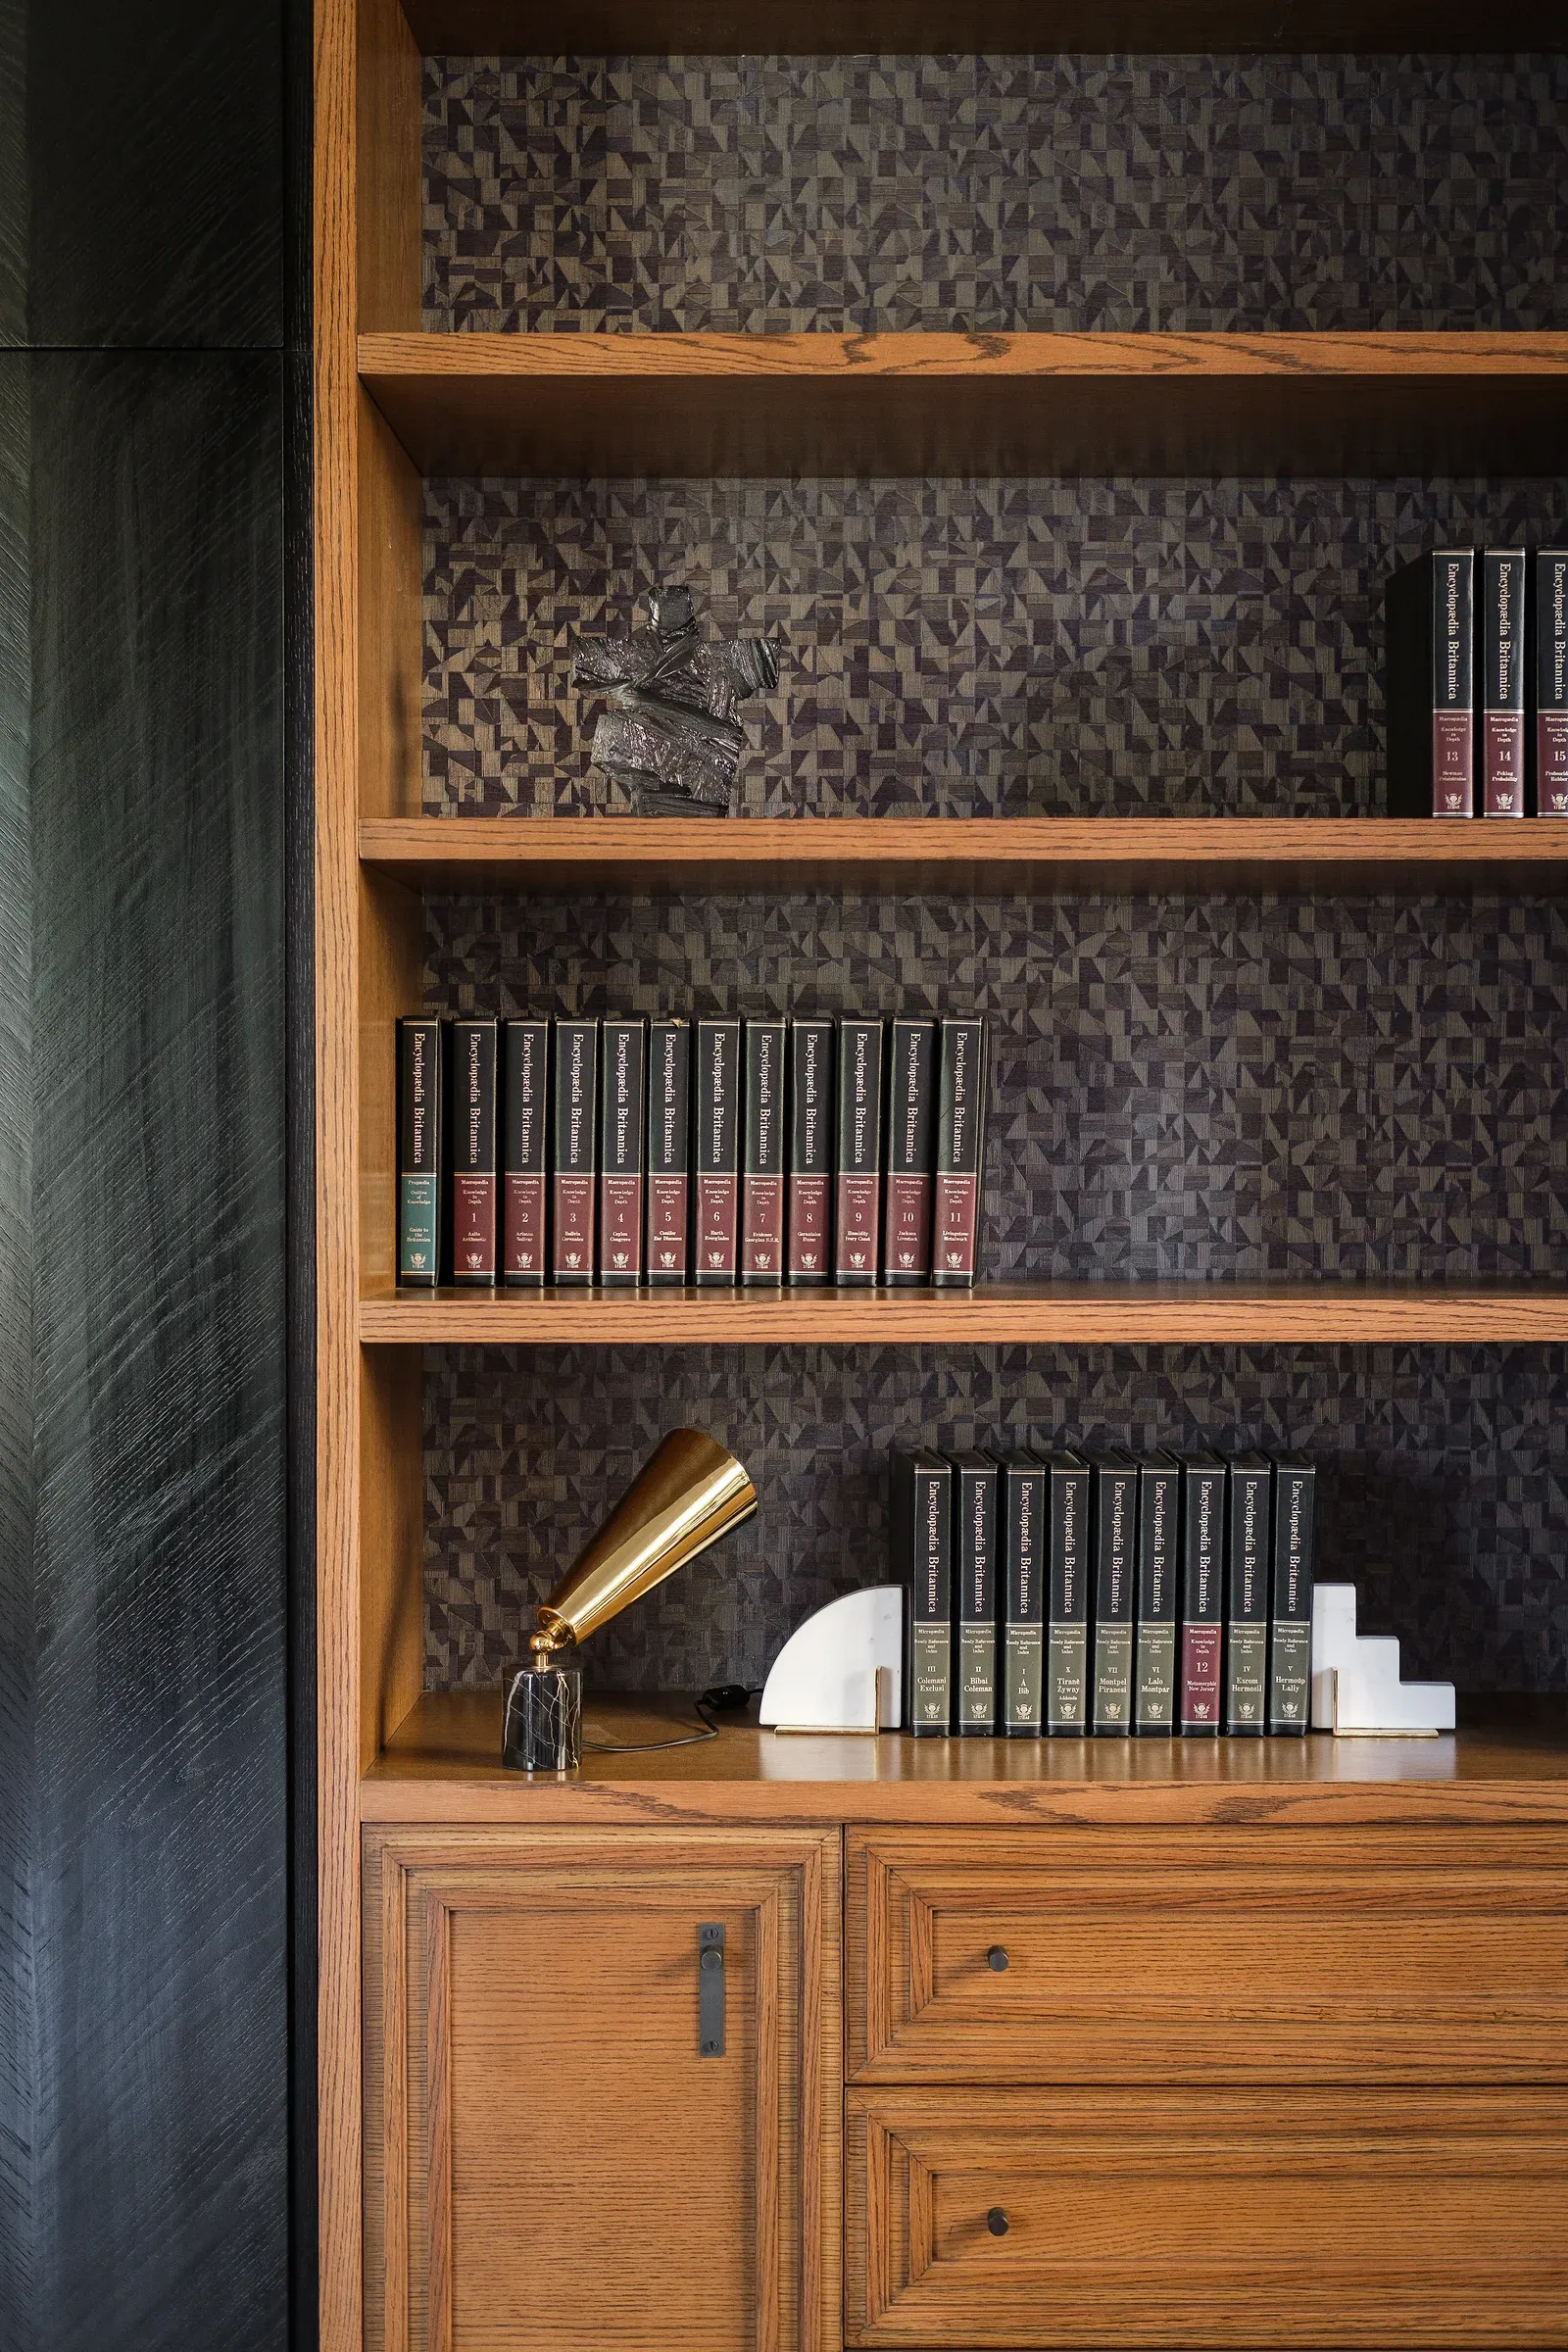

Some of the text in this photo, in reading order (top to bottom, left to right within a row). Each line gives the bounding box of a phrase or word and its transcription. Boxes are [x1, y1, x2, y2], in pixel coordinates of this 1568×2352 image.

[1446, 564, 1459, 700] Encyclopædia Britannica
[1498, 564, 1511, 700] Encyclopædia Britannica
[1553, 564, 1566, 700] Encyclopædia Britannica
[1446, 752, 1458, 760] 13
[1499, 752, 1511, 760] 14
[1554, 752, 1566, 760] 15
[413, 1033, 425, 1164] Encyclopædia Britannica
[468, 1034, 481, 1164] Encyclopædia Britannica
[521, 1034, 534, 1164] Encyclopædia Britannica
[570, 1034, 584, 1164] Encyclopædia Britannica
[615, 1034, 629, 1164] Encyclopædia Britannica
[662, 1034, 676, 1164] Encyclopædia Britannica
[711, 1033, 725, 1163] Encyclopædia Britannica
[759, 1034, 772, 1165] Encyclopædia Britannica
[805, 1034, 818, 1164] Encyclopædia Britannica
[855, 1033, 868, 1163] Encyclopædia Britannica
[906, 1033, 921, 1163] Encyclopædia Britannica
[954, 1032, 967, 1163] Encyclopædia Britannica
[471, 1213, 476, 1222] 1
[521, 1213, 529, 1222] 2
[570, 1213, 576, 1222] 3
[617, 1213, 623, 1223] 4
[665, 1212, 671, 1221] 5
[713, 1211, 719, 1221] 6
[760, 1213, 765, 1223] 7
[807, 1213, 812, 1222] 8
[855, 1212, 861, 1222] 9
[902, 1212, 913, 1222] 10
[950, 1212, 961, 1222] 11
[926, 1481, 940, 1614] Encyclopædia Britannica
[973, 1481, 986, 1613] Encyclopædia Britannica
[1019, 1482, 1032, 1614] Encyclopædia Britannica
[1064, 1481, 1077, 1614] Encyclopædia Britannica
[1111, 1481, 1125, 1614] Encyclopædia Britannica
[1152, 1481, 1166, 1613] Encyclopædia Britannica
[1199, 1481, 1212, 1613] Encyclopædia Britannica
[1243, 1481, 1257, 1613] Encyclopædia Britannica
[1288, 1481, 1303, 1612] Encyclopædia Britannica
[1196, 1663, 1208, 1673] 12
